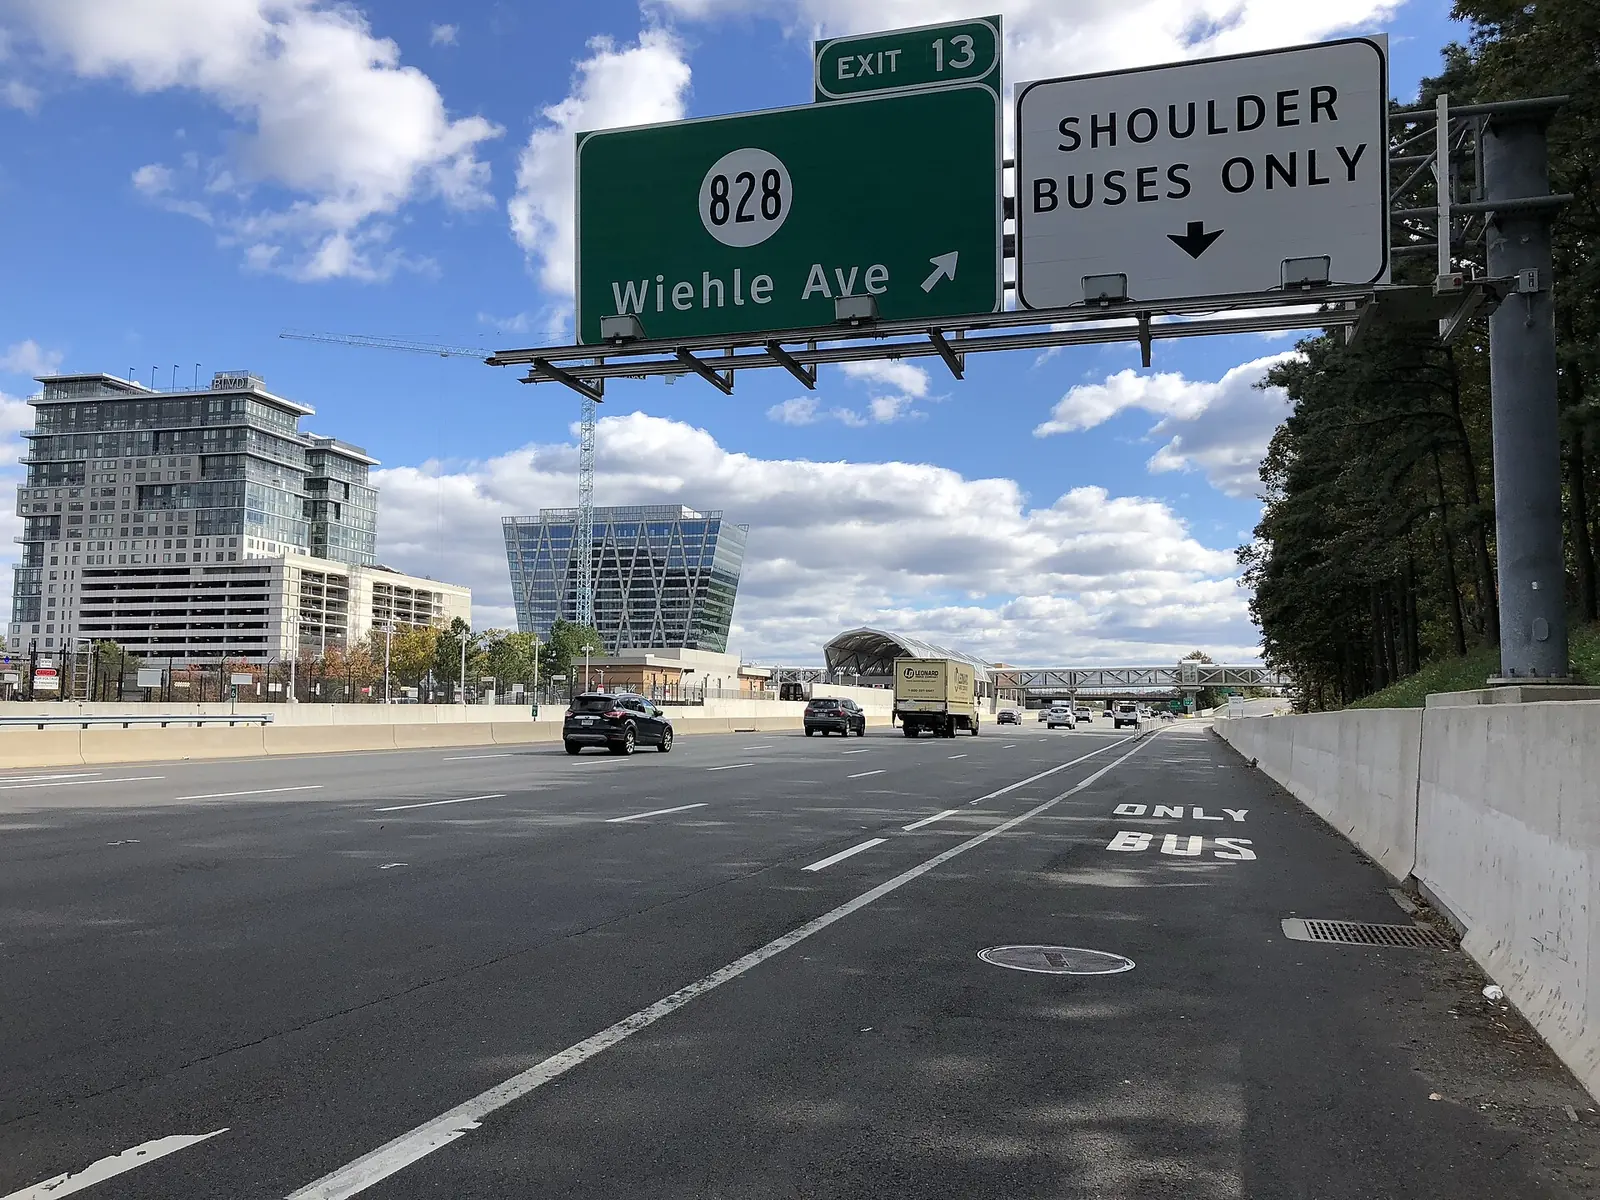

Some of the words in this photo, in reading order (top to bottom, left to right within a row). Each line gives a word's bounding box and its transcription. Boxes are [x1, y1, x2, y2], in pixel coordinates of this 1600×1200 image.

[838, 49, 901, 80] EXIT
[932, 35, 975, 72] 13
[1058, 85, 1339, 151] SHOULDER
[709, 168, 782, 226] 828
[1033, 163, 1191, 213] BUSES
[1221, 143, 1367, 193] ONLY
[612, 268, 774, 314] Wiehle
[801, 263, 889, 300] Ave
[213, 378, 245, 390] BLVD
[1112, 803, 1249, 822] ONLY
[1105, 830, 1257, 861] BUS
